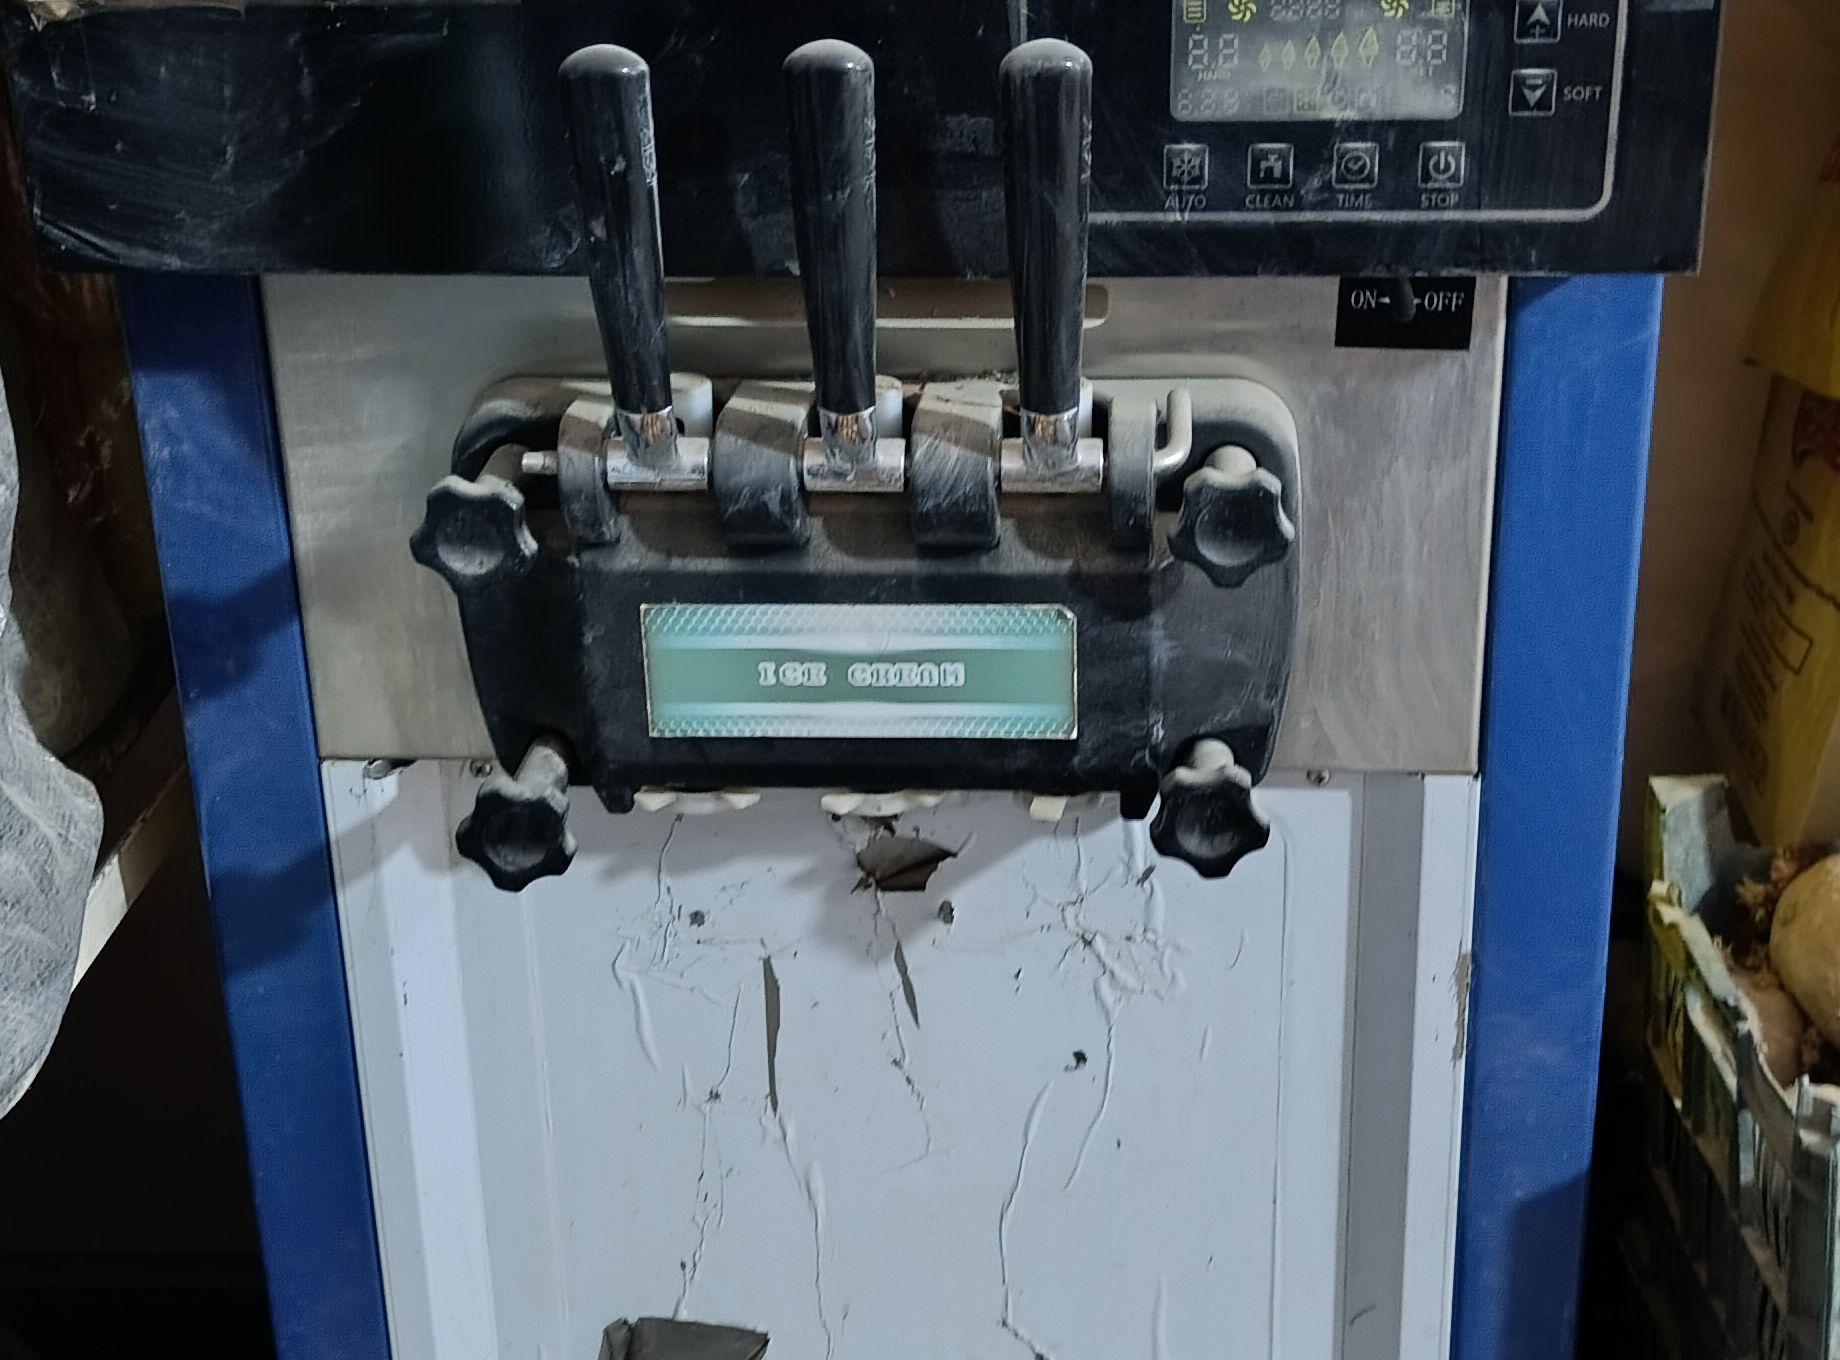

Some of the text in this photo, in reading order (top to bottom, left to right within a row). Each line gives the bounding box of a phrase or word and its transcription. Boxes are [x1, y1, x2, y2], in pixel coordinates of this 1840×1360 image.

[1567, 13, 1610, 29] HARD
[1562, 85, 1603, 102] SOFT
[1164, 194, 1207, 209] AUTO
[1245, 193, 1295, 209] CLEAN
[1335, 193, 1373, 209] TIME
[1420, 192, 1460, 209] STOP
[1350, 289, 1377, 311] ON
[1423, 291, 1465, 313] OFF
[758, 661, 967, 688] ICE CREAM
